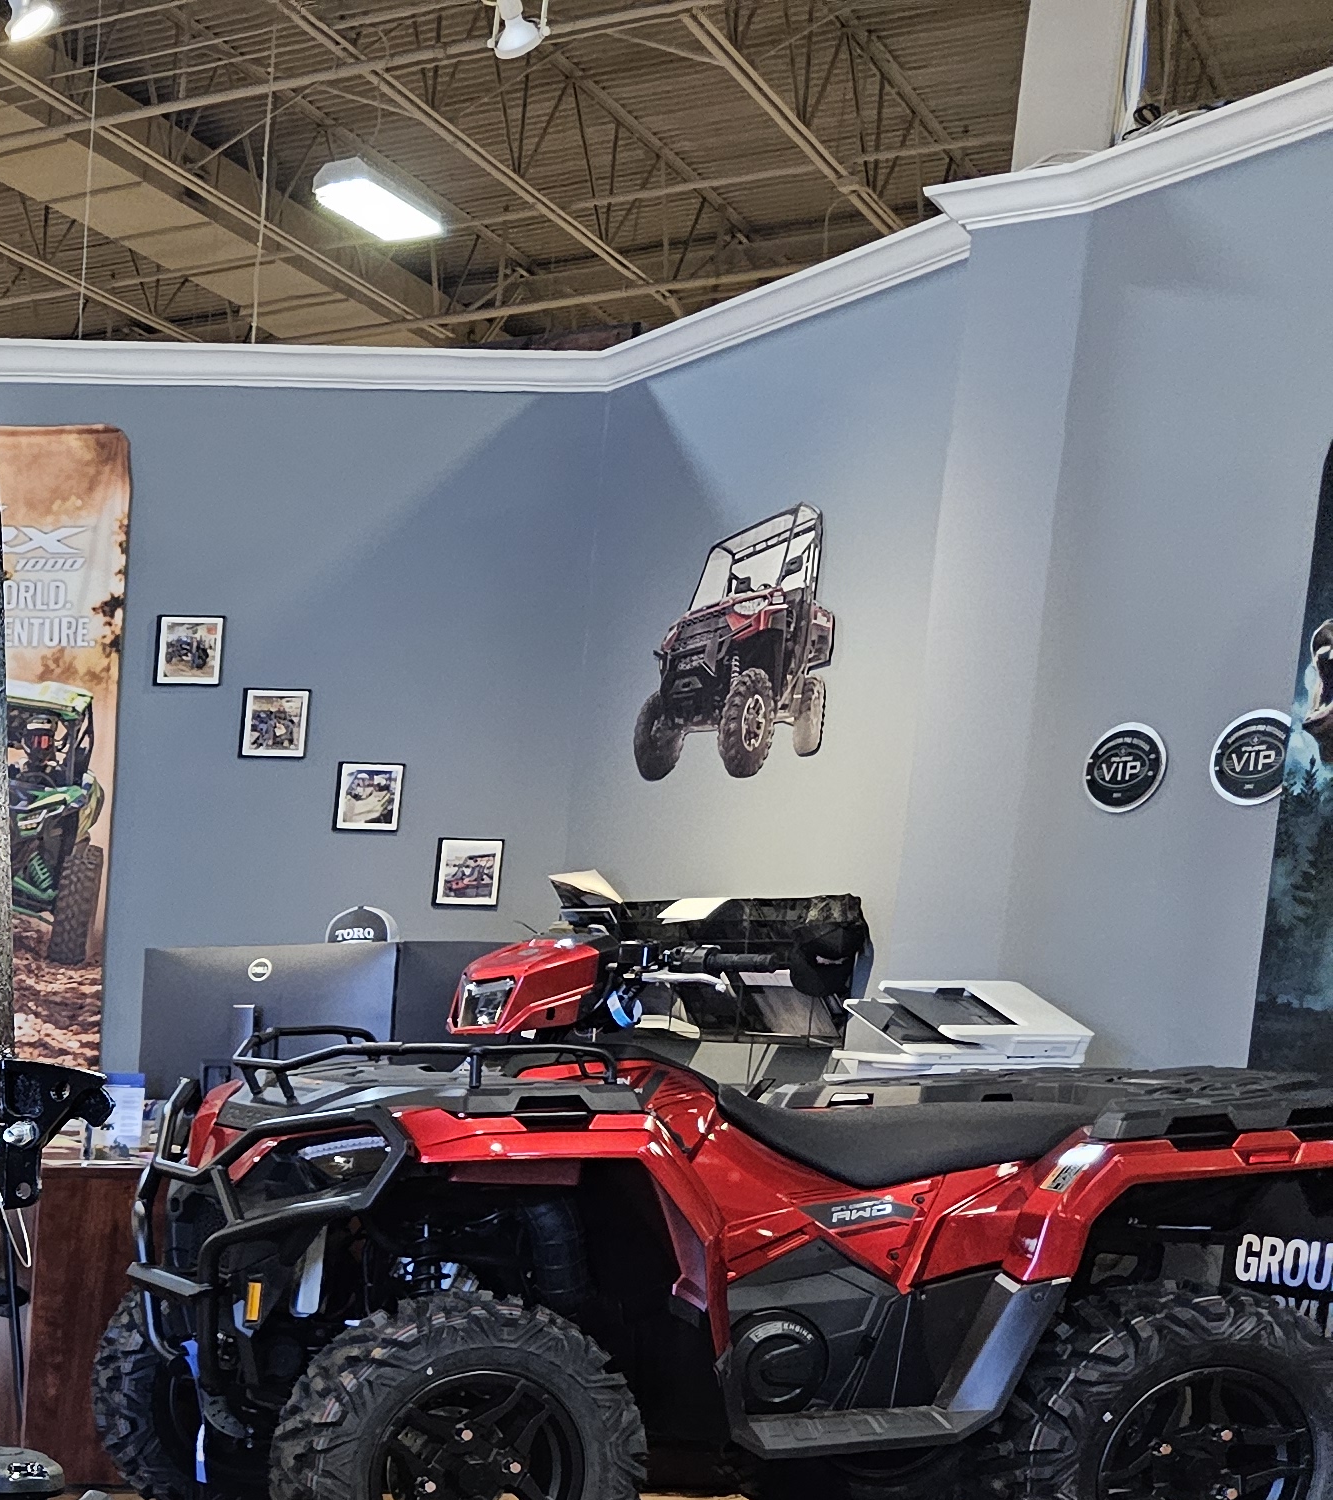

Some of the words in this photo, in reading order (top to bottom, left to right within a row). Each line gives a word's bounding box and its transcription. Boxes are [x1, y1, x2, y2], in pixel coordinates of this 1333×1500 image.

[15, 558, 85, 571] 1000
[3, 580, 72, 610] ORLD.
[4, 617, 95, 647] ENTURE.
[1102, 761, 1141, 781] VIP
[1231, 750, 1275, 772] VIP
[832, 1203, 893, 1222] AWD
[1235, 1233, 1333, 1290] GROU
